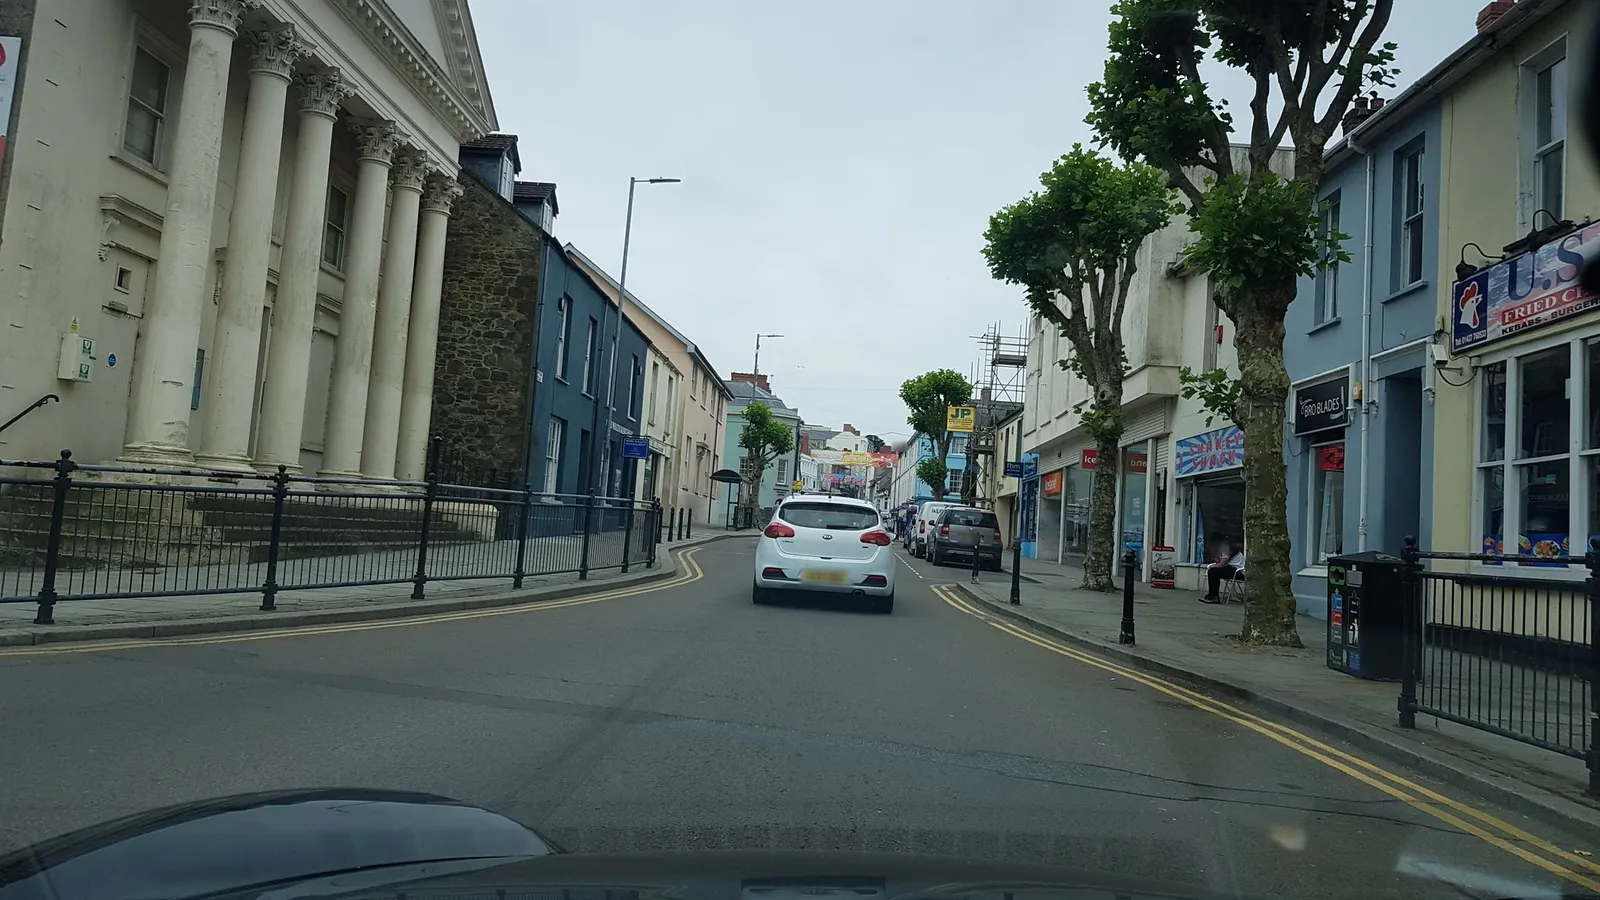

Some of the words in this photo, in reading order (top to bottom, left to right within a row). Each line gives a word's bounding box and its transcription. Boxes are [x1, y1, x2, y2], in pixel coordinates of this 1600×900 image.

[1502, 316, 1542, 335] KEBABS
[1551, 297, 1600, 319] BURGER
[1503, 296, 1557, 323] FRIED
[950, 408, 972, 419] JP
[1304, 403, 1317, 418] BRO
[1316, 397, 1340, 415] BLADES
[1189, 432, 1241, 457] SHAKEY
[1192, 450, 1237, 469] SHACK
